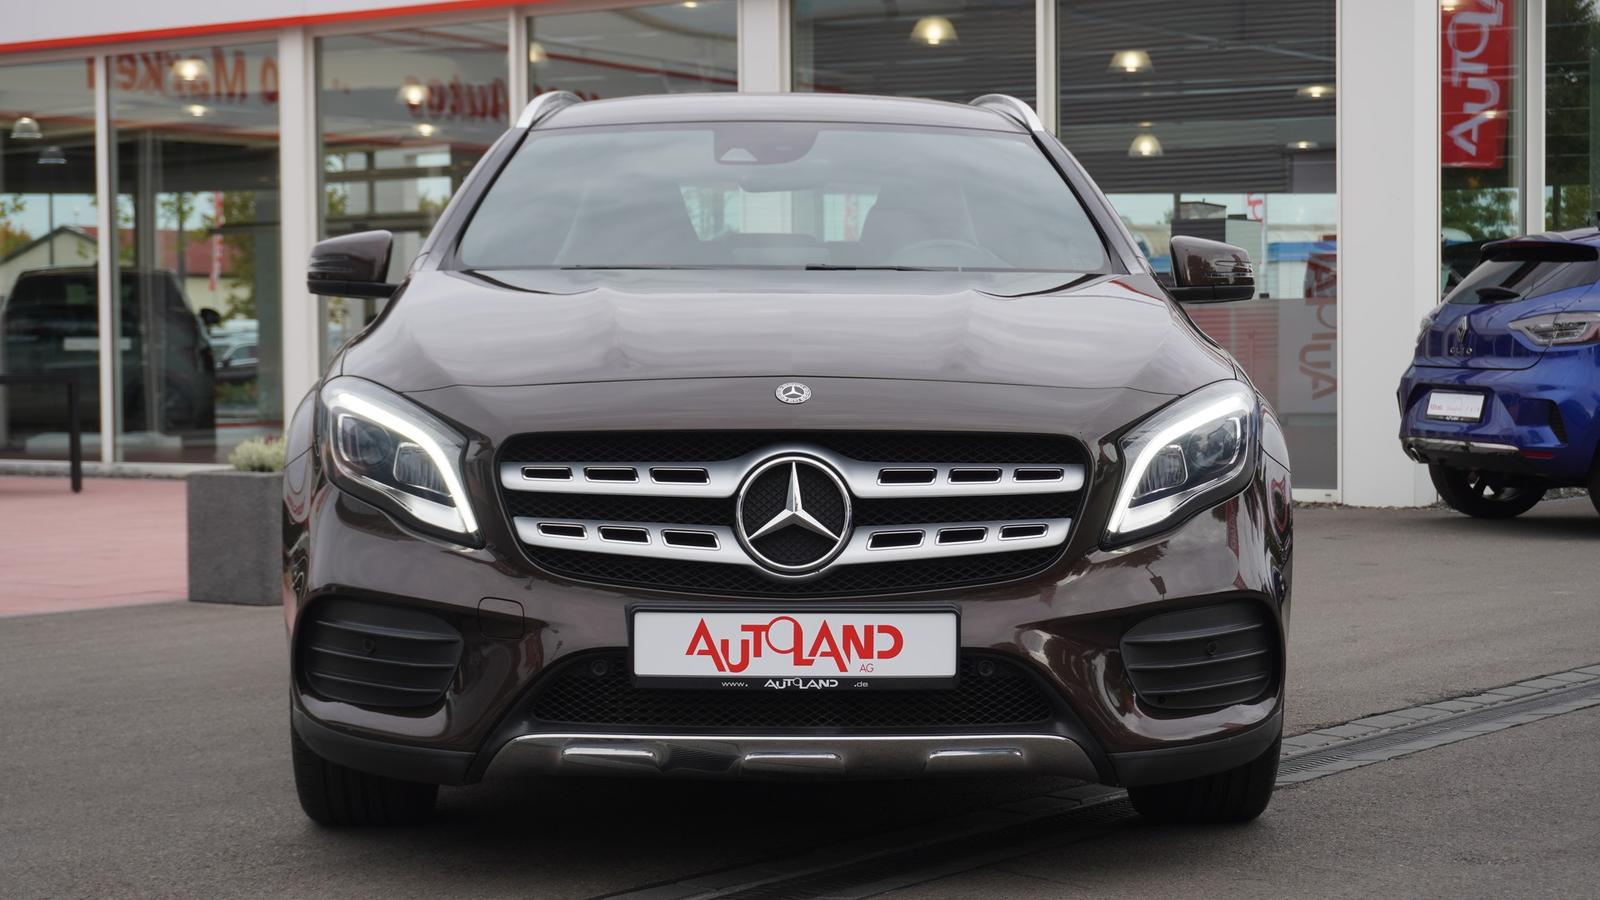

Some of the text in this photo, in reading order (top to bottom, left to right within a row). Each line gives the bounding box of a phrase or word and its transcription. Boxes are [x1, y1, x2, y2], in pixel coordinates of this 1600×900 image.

[685, 615, 904, 673] AUTOLAND
[859, 663, 874, 673] AG
[763, 677, 838, 690] AUTOLAND
[853, 680, 869, 688] .de
